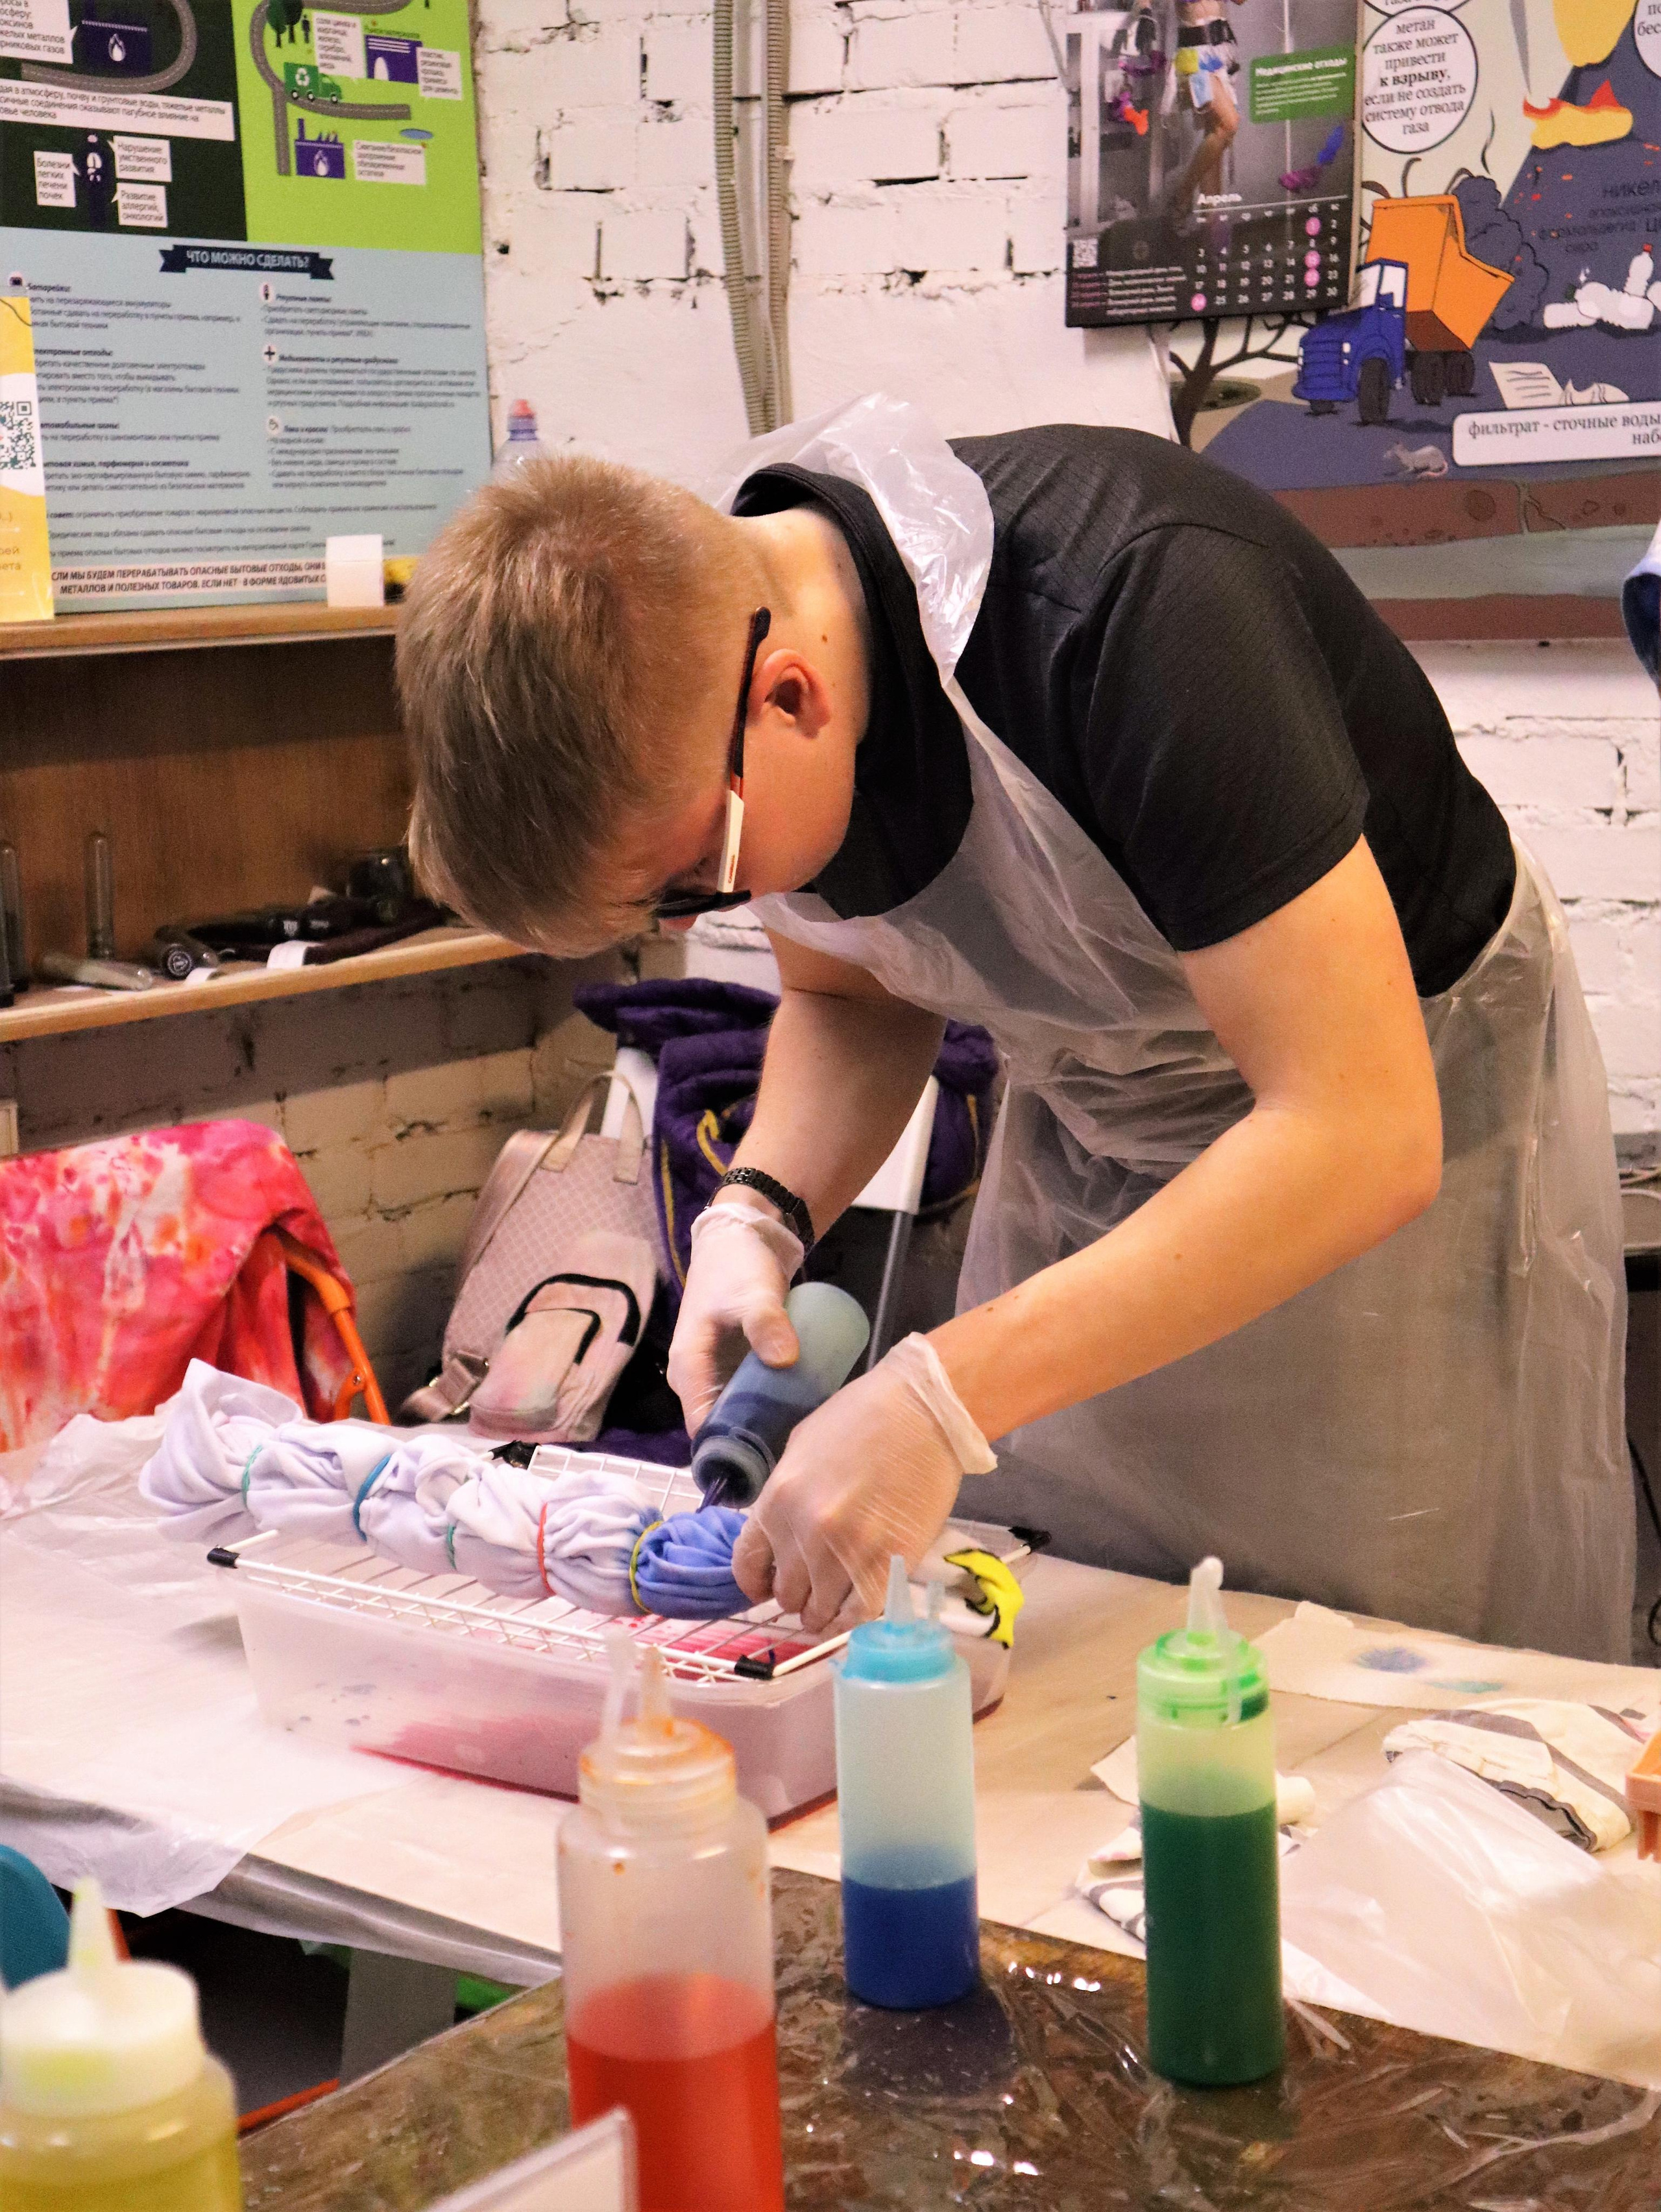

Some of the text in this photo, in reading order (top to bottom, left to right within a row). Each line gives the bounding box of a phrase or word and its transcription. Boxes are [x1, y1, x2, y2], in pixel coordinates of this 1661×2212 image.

[1396, 19, 1435, 34] метан
[27, 33, 65, 43] металлов
[1373, 33, 1459, 55] также может
[42, 45, 65, 55] газов
[1385, 53, 1446, 72] привести
[1380, 69, 1451, 88] к взрыву,
[1364, 84, 1466, 106] если не создать
[1365, 101, 1464, 122] систему отвода
[1403, 122, 1430, 135] газа
[1331, 219, 1337, 229] 2
[186, 249, 311, 269] ЧТО МОЖНО СДЕЛАТЬ?
[1221, 246, 1228, 255] 4
[1468, 421, 1540, 439] фильтрат
[1553, 415, 1618, 431] сточные
[1622, 413, 1661, 428] воды
[1632, 428, 1661, 445] наб
[51, 572, 68, 581] СЛИ
[70, 571, 85, 580] МЫ
[86, 570, 115, 580] БУДЕМ
[116, 567, 188, 579] ПЕРЕРАБАТЫВАТЬ
[189, 565, 229, 576] ОПАСНЫЕ
[230, 563, 268, 574] БЫТОВЫЕ
[304, 562, 321, 570] ОНИ
[60, 574, 320, 594] МЕТАЛЛОВ И ПОЛЕЗНЫХ ТОВАРОВ. ЕСЛИ НЕТ В ФОРМЕ ЯДОВИТЫХ
